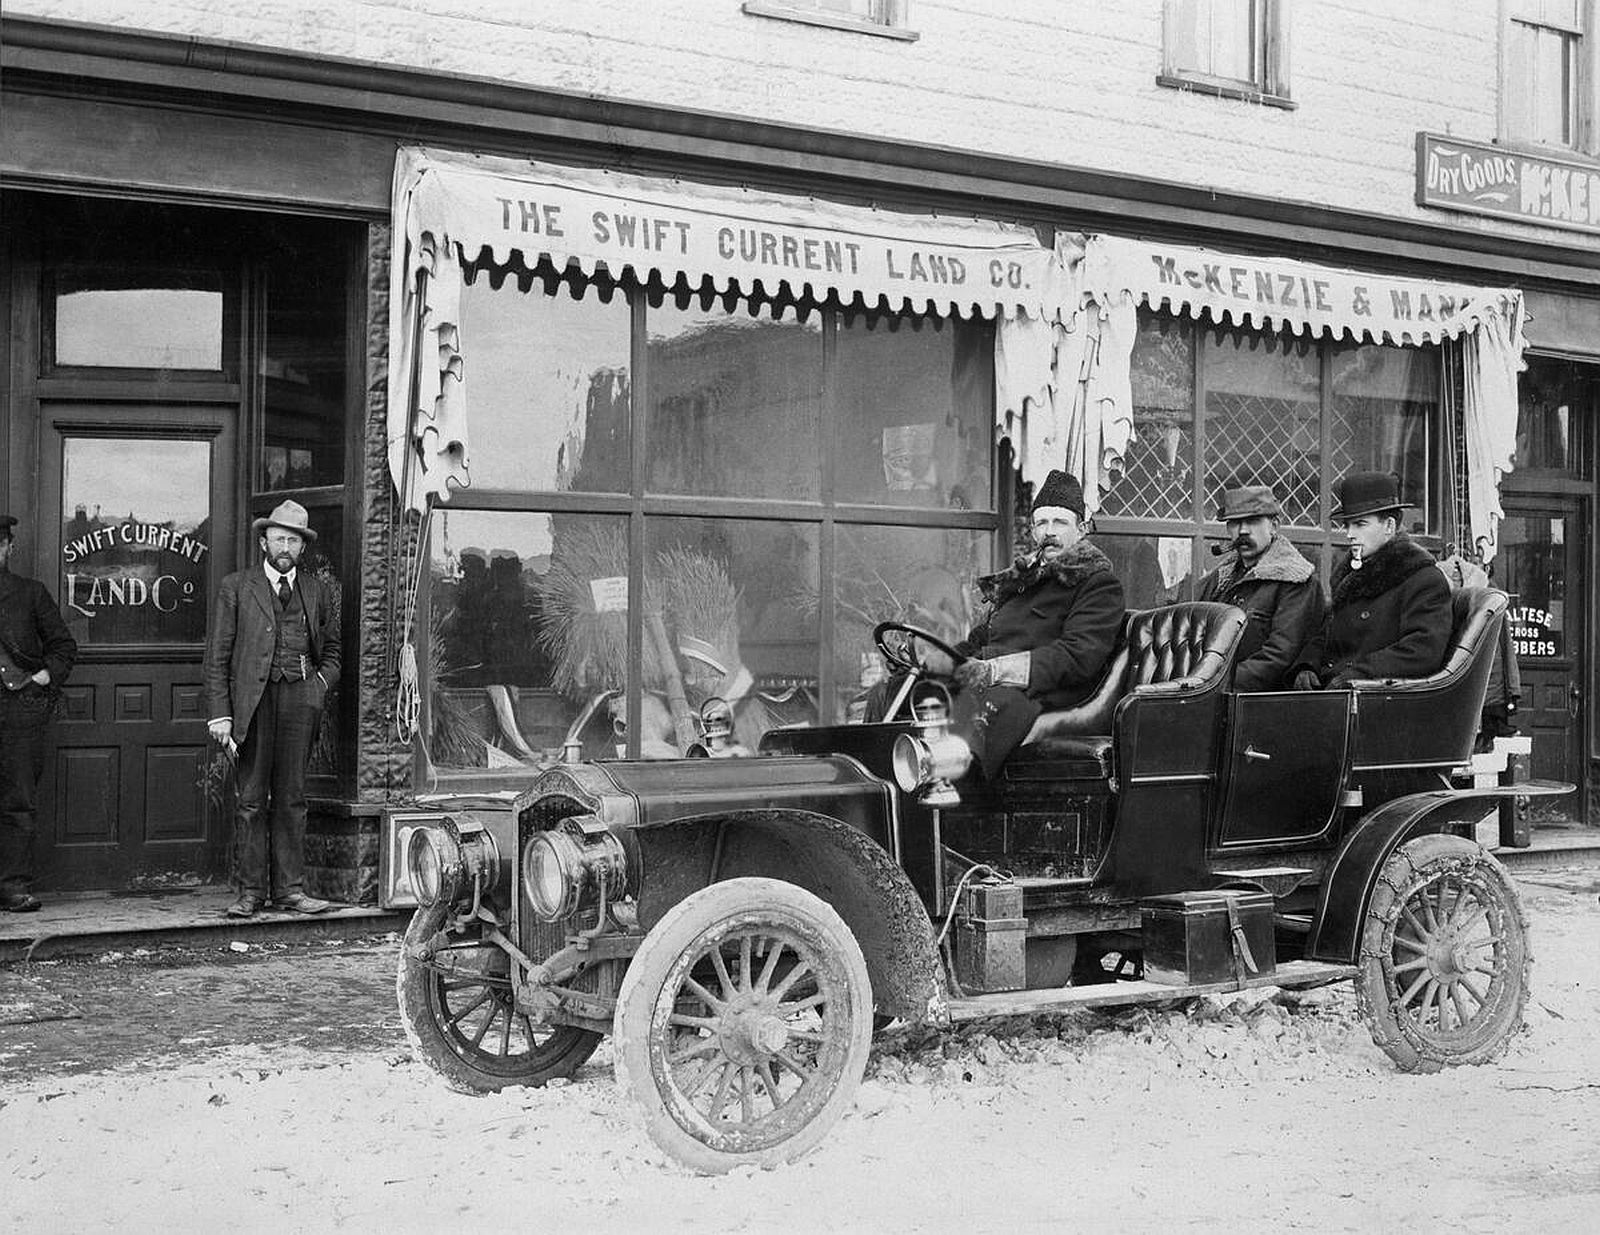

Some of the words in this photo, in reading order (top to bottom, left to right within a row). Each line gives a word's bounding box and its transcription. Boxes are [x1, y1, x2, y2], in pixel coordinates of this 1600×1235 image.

[496, 197, 564, 237] THE
[592, 211, 690, 255] SWIFT
[717, 226, 861, 275] CURRENT
[886, 248, 967, 286] LAND
[988, 259, 1031, 290] CO.
[1152, 255, 1333, 313] McKENZIE
[1352, 286, 1373, 317] &
[1389, 288, 1475, 322] MAN
[63, 526, 116, 562] SWIFT
[121, 524, 208, 563] CURRENT
[67, 574, 147, 617] LAND
[1505, 606, 1553, 628] ALTESE
[1512, 640, 1556, 655] BBERS
